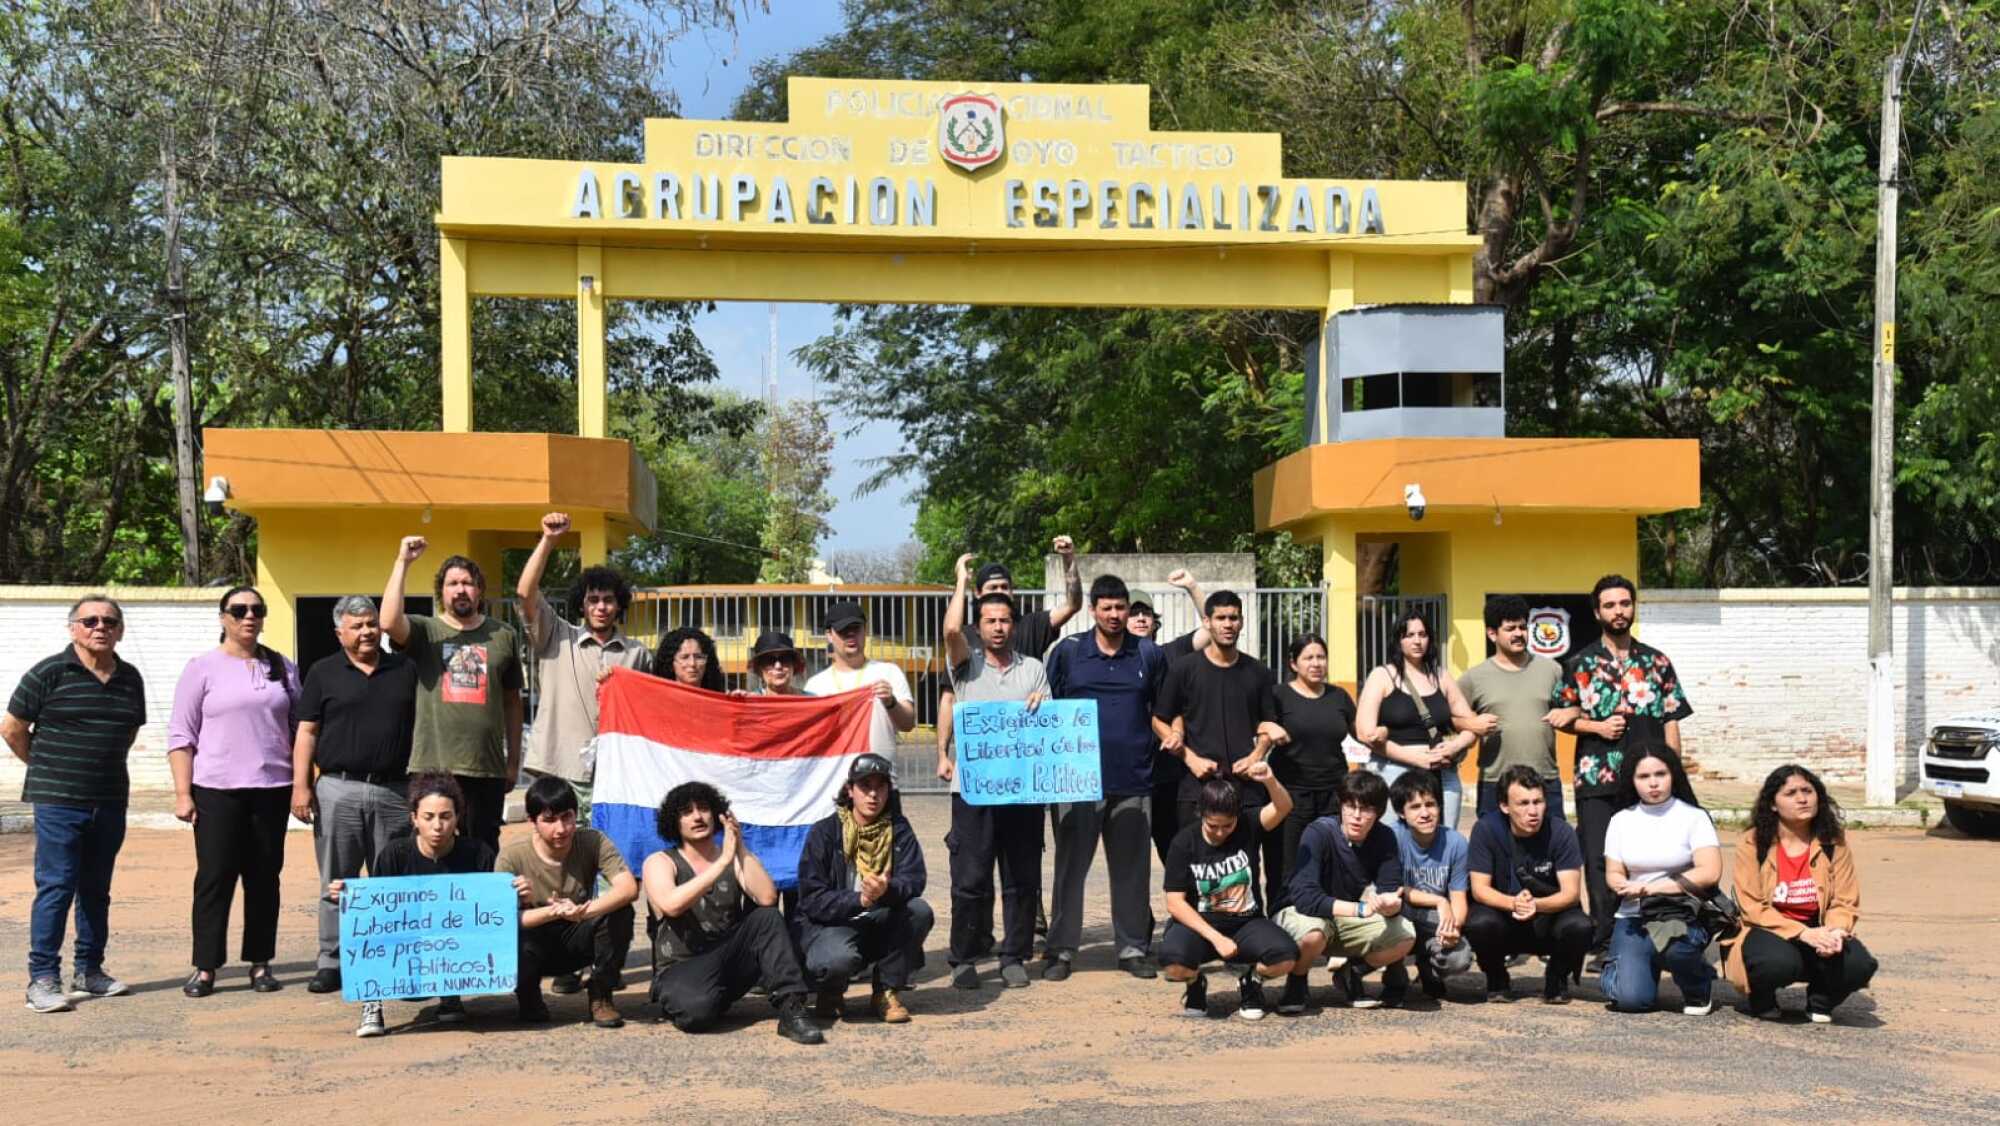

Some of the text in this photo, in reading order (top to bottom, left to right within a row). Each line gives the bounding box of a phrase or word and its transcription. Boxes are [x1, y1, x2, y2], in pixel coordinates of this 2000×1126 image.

[1006, 95, 1113, 123] CIONAL
[695, 132, 852, 162] DIRECCION
[889, 141, 931, 165] DE
[1110, 143, 1238, 169] TACTICO
[572, 171, 1386, 235] AGRUPACION ESPECIALIZADA
[1190, 849, 1249, 880] WANTED
[449, 882, 466, 902] la
[352, 902, 505, 938] Libertad de las
[346, 937, 460, 968] y los presos
[443, 977, 486, 992] NUNCA
